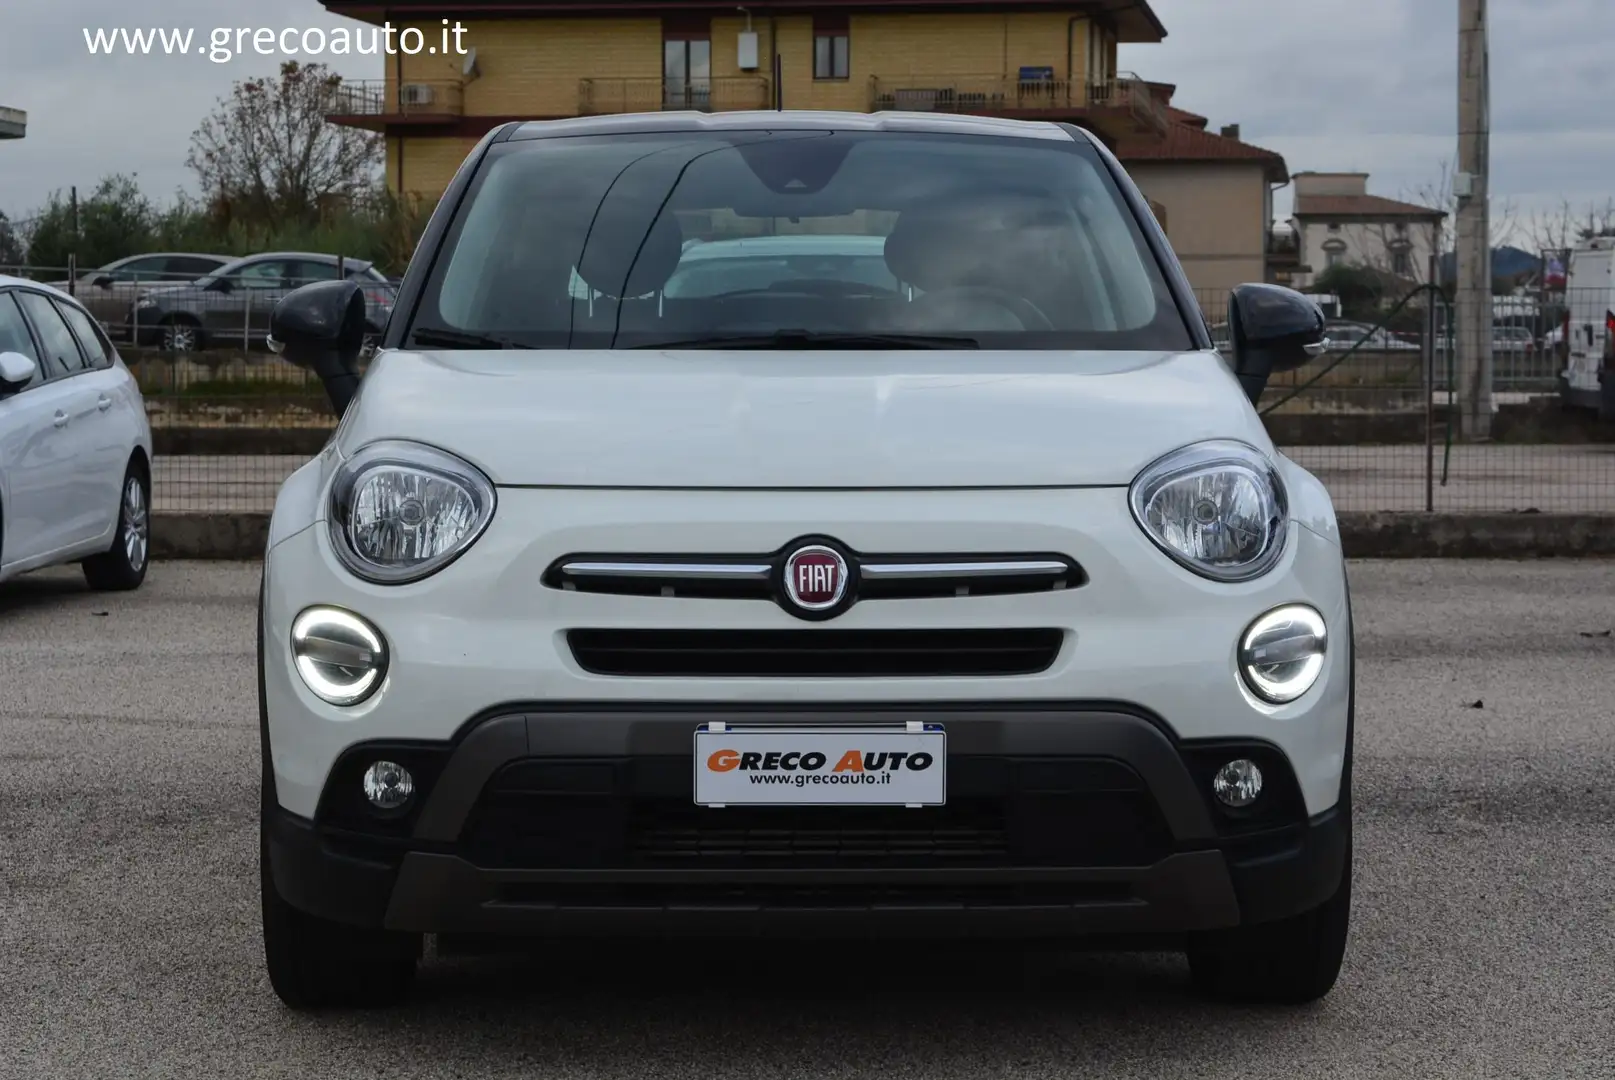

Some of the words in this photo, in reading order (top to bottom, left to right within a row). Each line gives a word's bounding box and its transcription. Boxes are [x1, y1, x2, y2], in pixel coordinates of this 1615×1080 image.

[799, 564, 835, 592] FIAT
[707, 749, 827, 772] GRECO
[832, 750, 933, 772] AUTO
[750, 772, 891, 787] www.grecoauto.it
